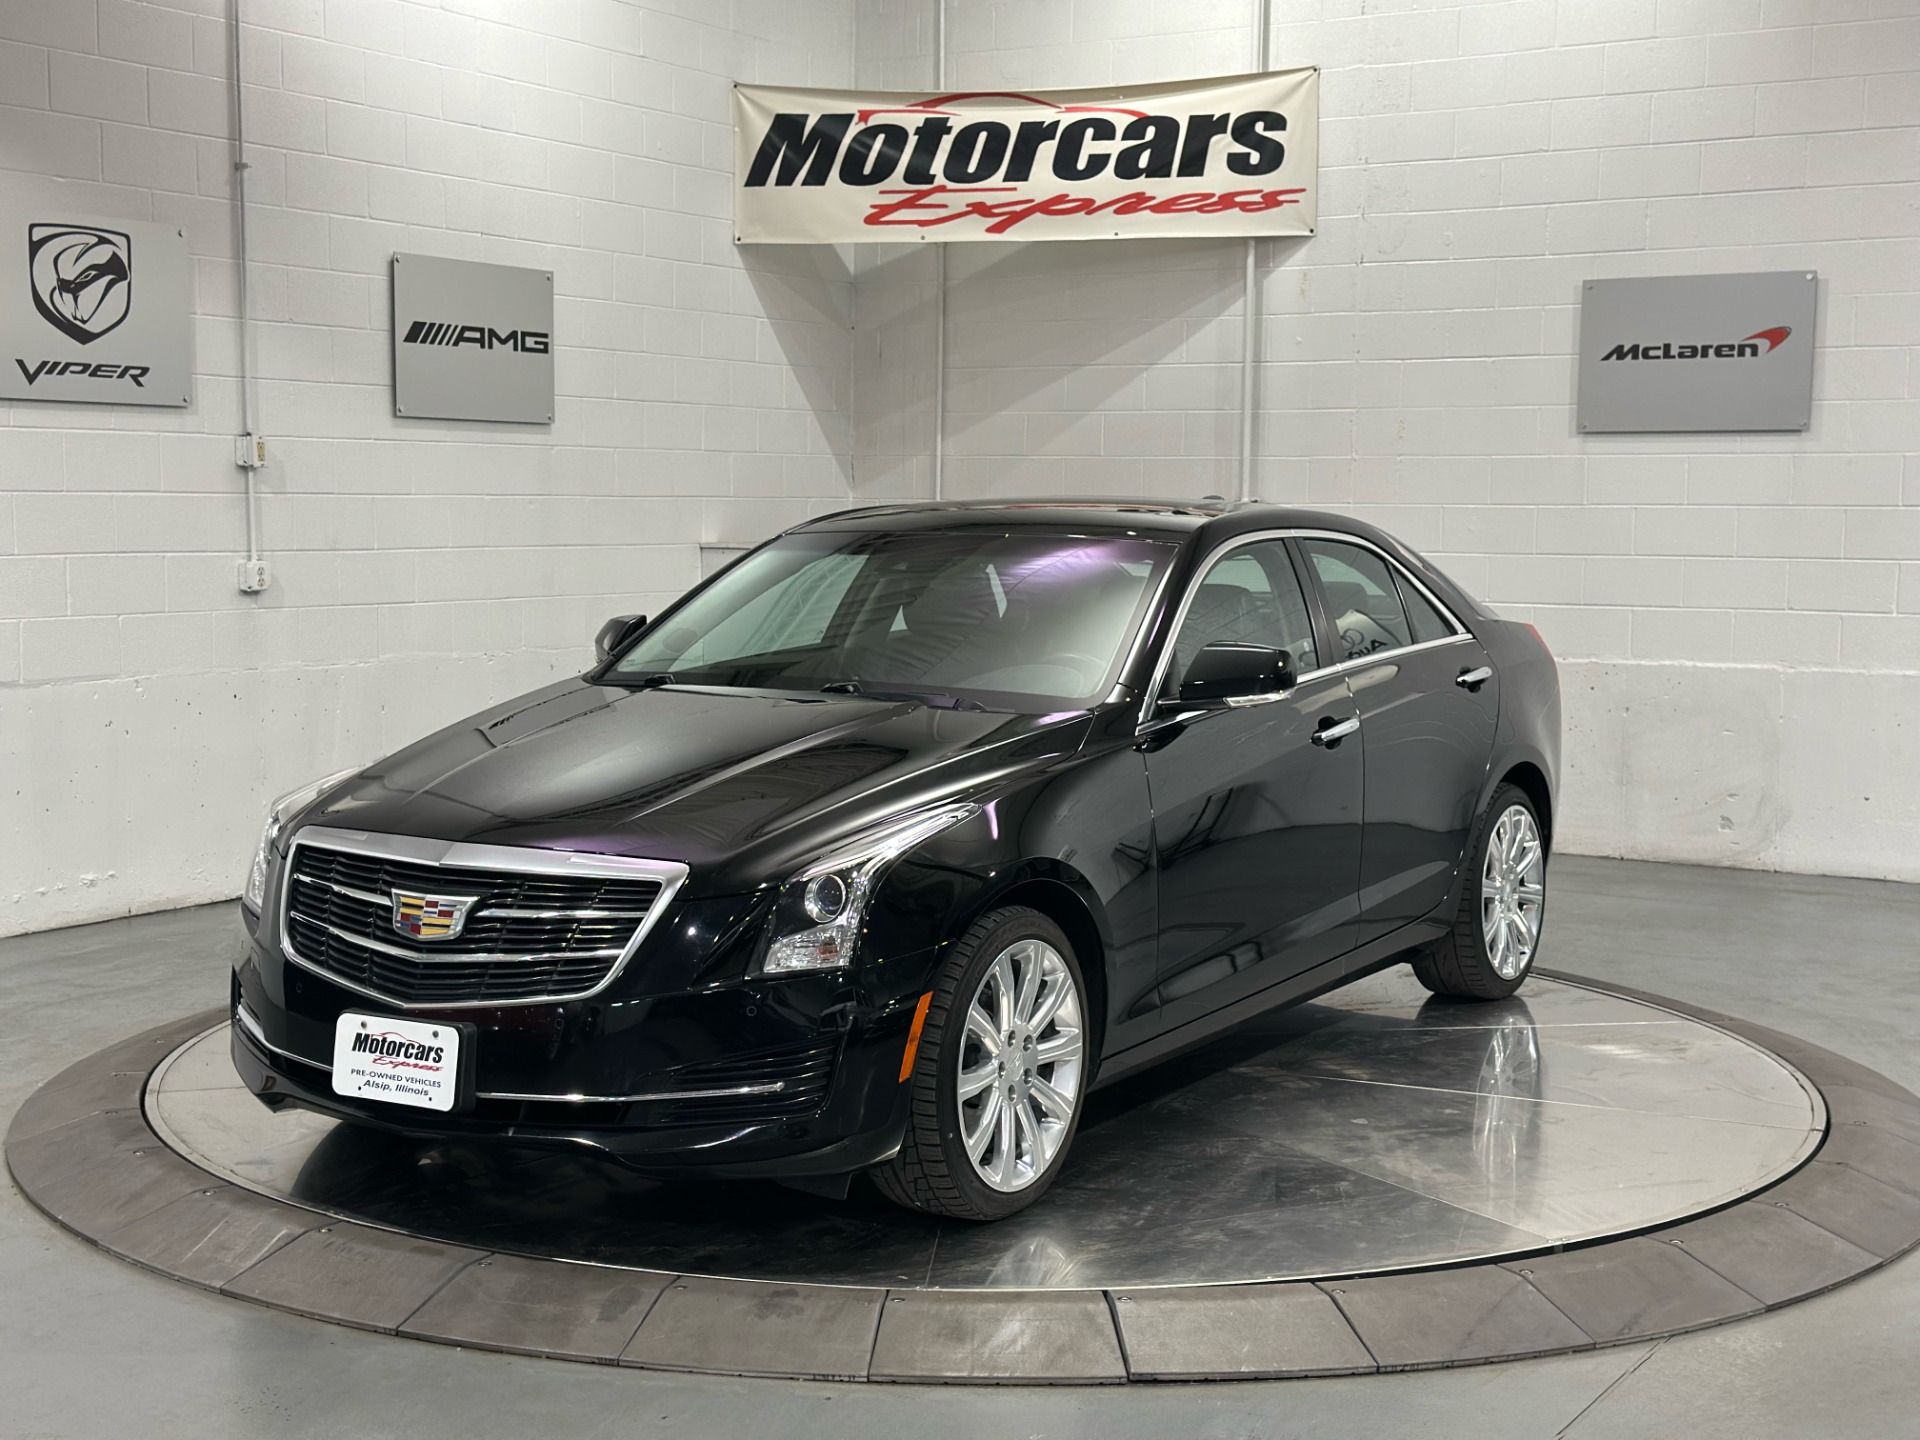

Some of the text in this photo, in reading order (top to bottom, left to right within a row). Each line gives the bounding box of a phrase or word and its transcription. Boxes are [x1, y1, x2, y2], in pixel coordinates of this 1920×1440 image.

[743, 110, 1288, 188] Motorcars
[863, 184, 1307, 234] Express
[451, 328, 549, 354] AMG
[1600, 342, 1758, 361] McLaren
[15, 358, 151, 388] VIPER
[351, 1032, 444, 1063] Motorcars
[372, 1054, 443, 1072] Express
[350, 1068, 442, 1088] PRE-OWNED VEHICLES
[363, 1079, 429, 1096] Alsip, Illinois
